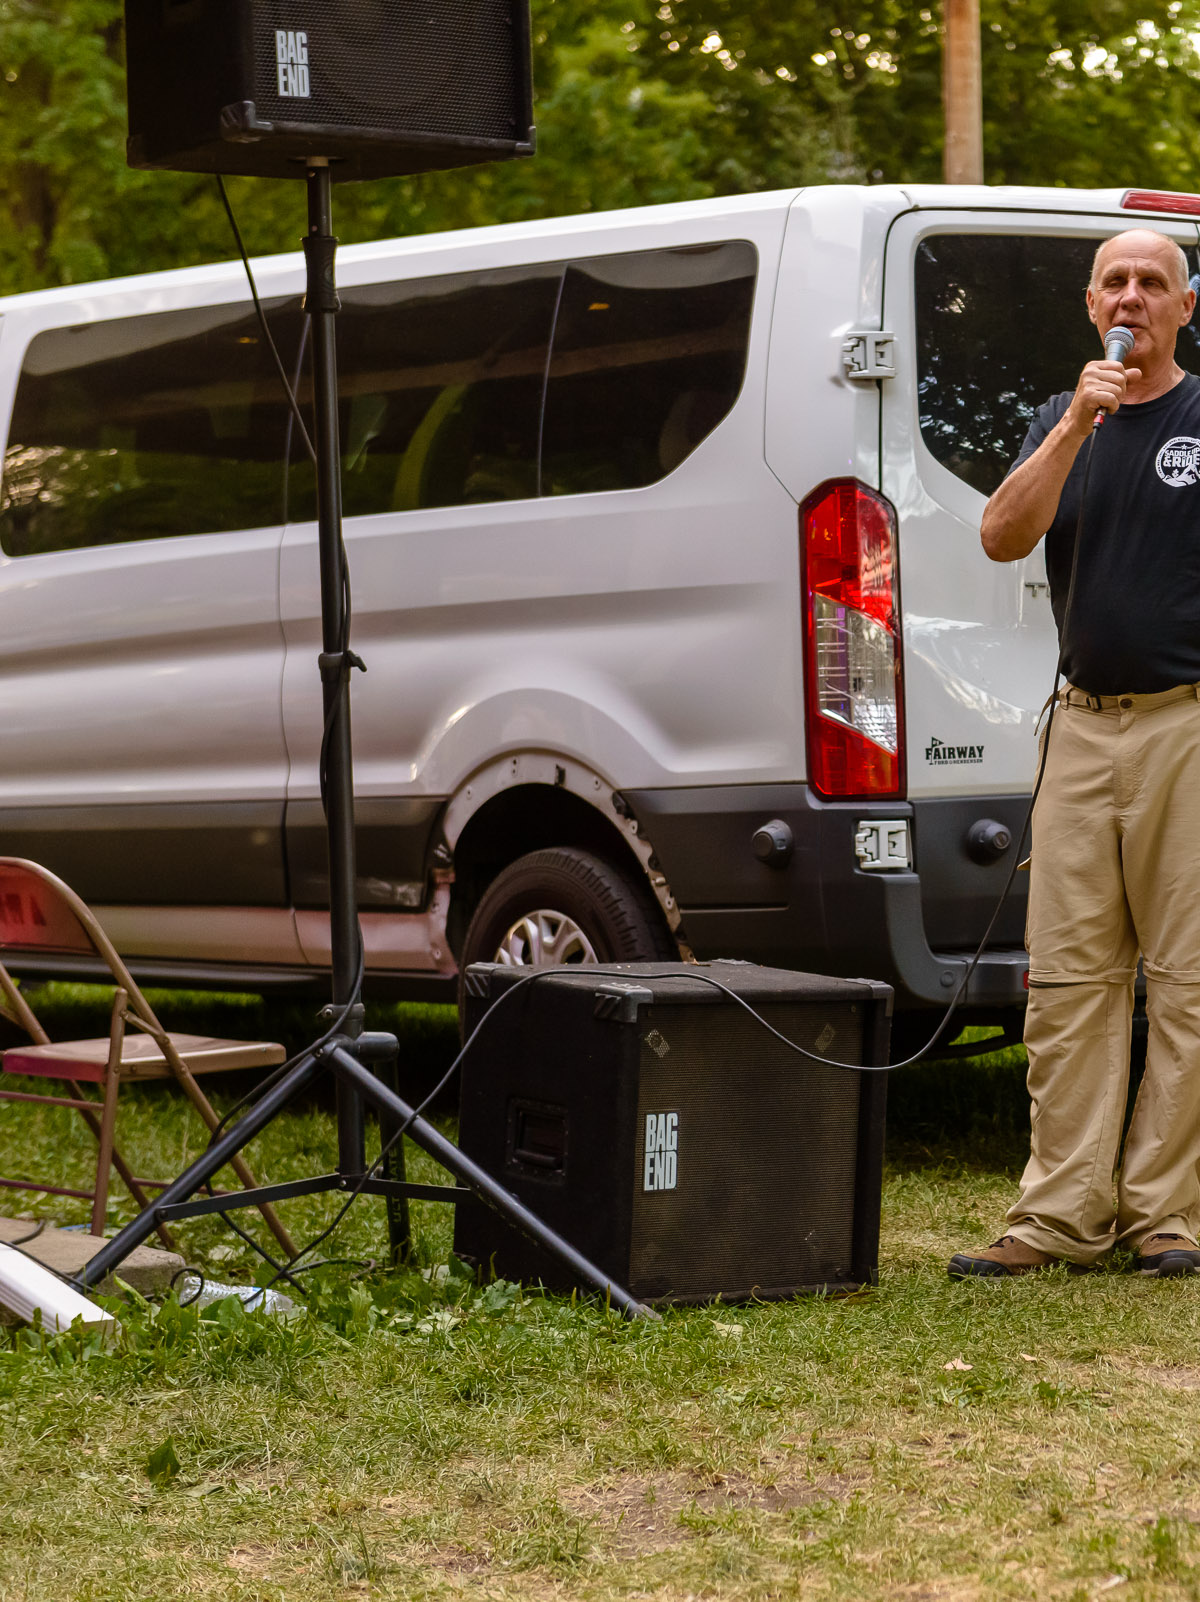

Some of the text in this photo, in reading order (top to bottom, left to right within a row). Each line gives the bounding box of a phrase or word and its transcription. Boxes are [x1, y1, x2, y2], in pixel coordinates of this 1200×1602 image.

[276, 30, 308, 64] BAG
[278, 64, 310, 97] END
[1164, 447, 1200, 457] SADDLE UP
[925, 746, 984, 760] FAIRWAY
[645, 1113, 678, 1152] BAG
[644, 1151, 677, 1191] END
